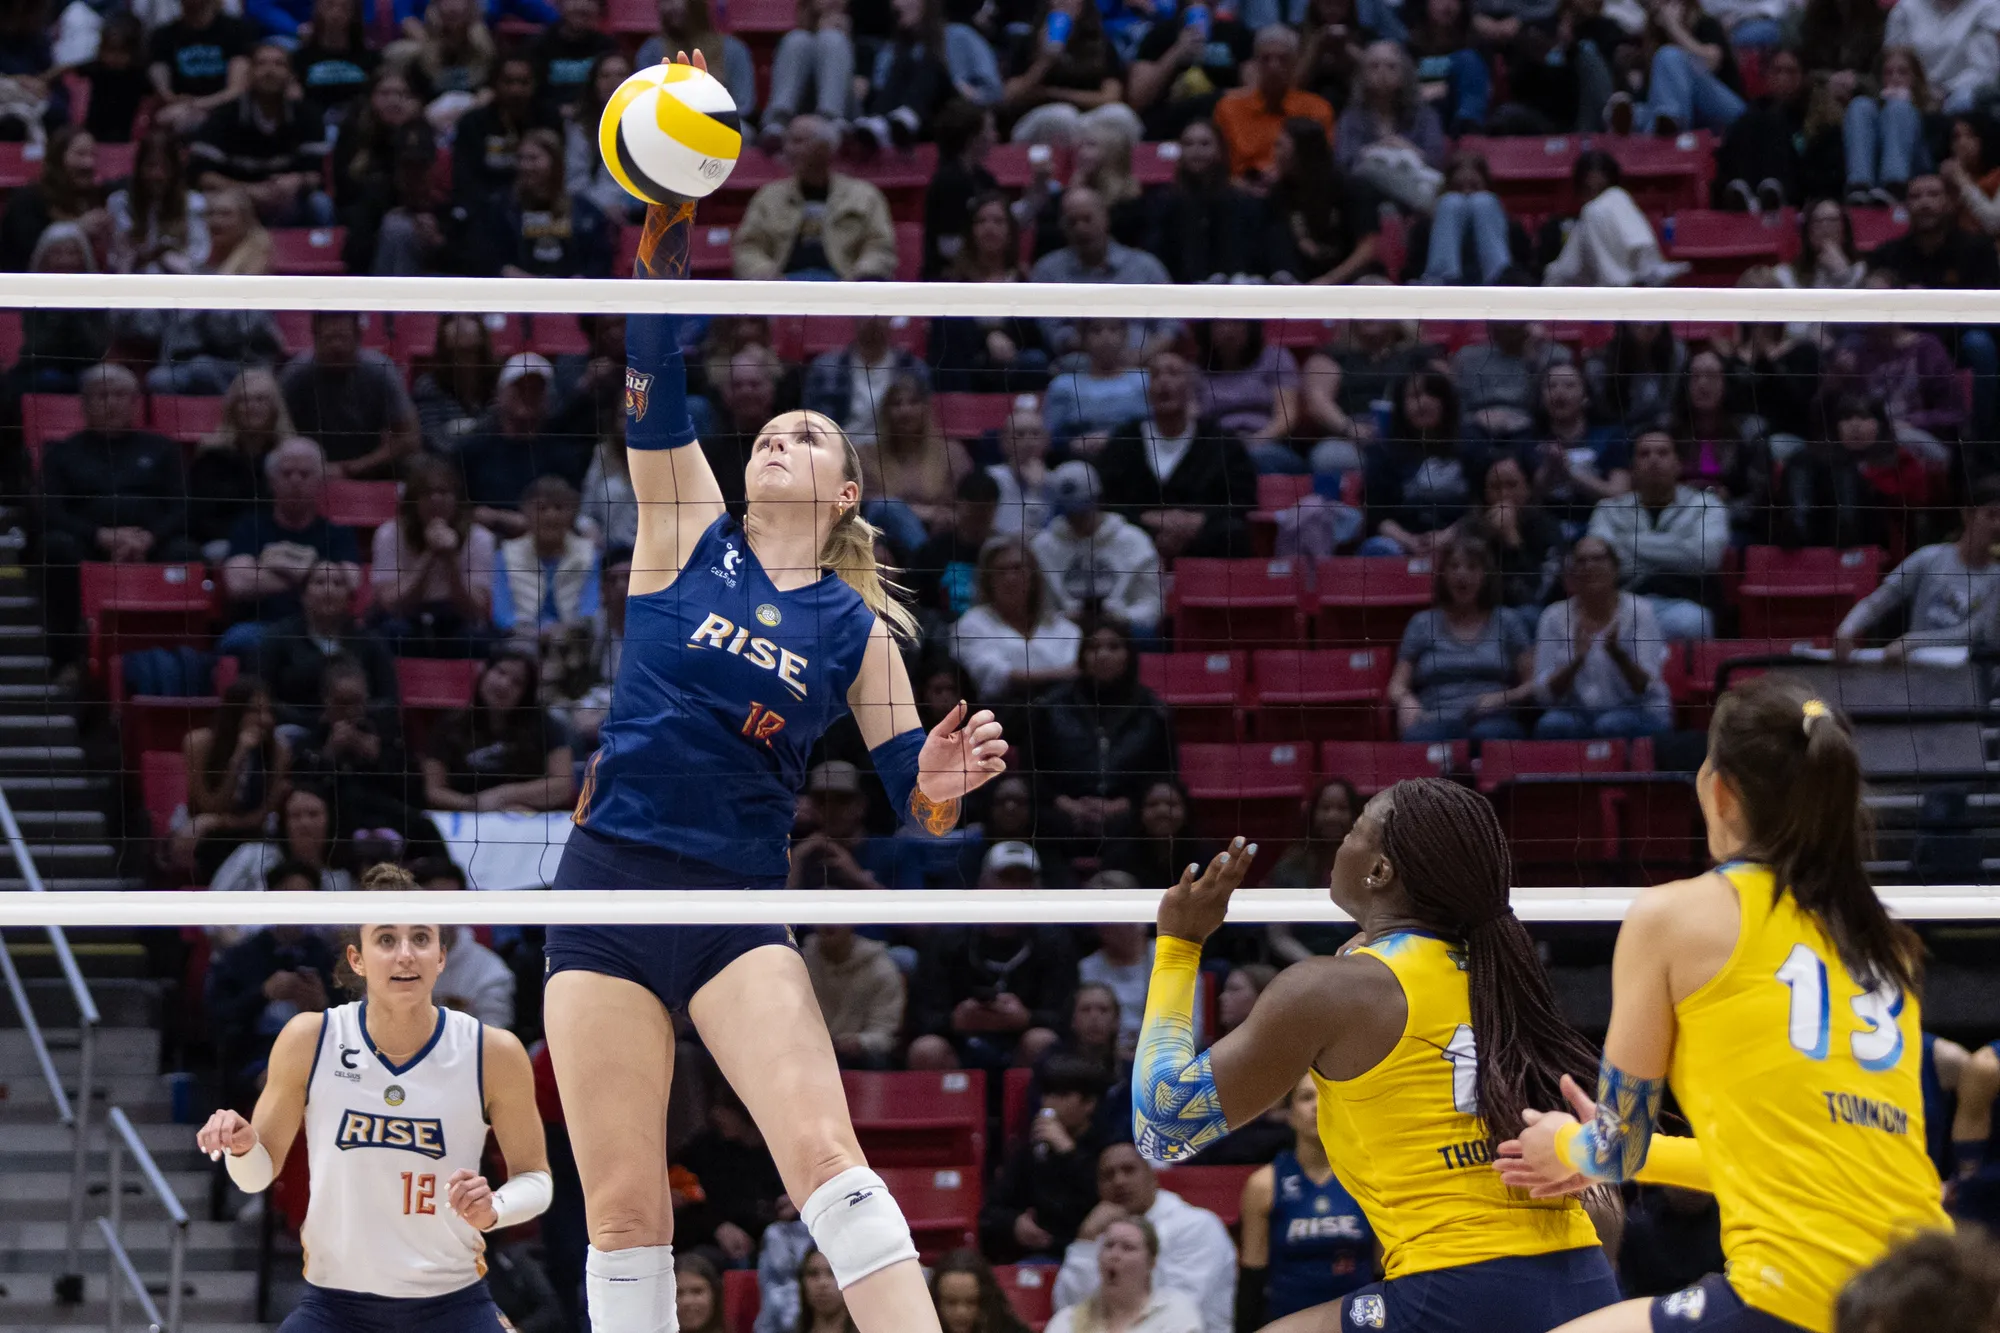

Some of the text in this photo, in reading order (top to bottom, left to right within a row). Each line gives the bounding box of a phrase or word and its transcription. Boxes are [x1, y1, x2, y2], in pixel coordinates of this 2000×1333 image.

[691, 611, 808, 697] RISE
[1775, 943, 1904, 1072] 13
[340, 1112, 443, 1151] RISE
[1822, 1090, 1908, 1135] TOMKOM
[1437, 1138, 1495, 1170] THO
[400, 1171, 436, 1215] 12
[1287, 1215, 1363, 1242] RISE
